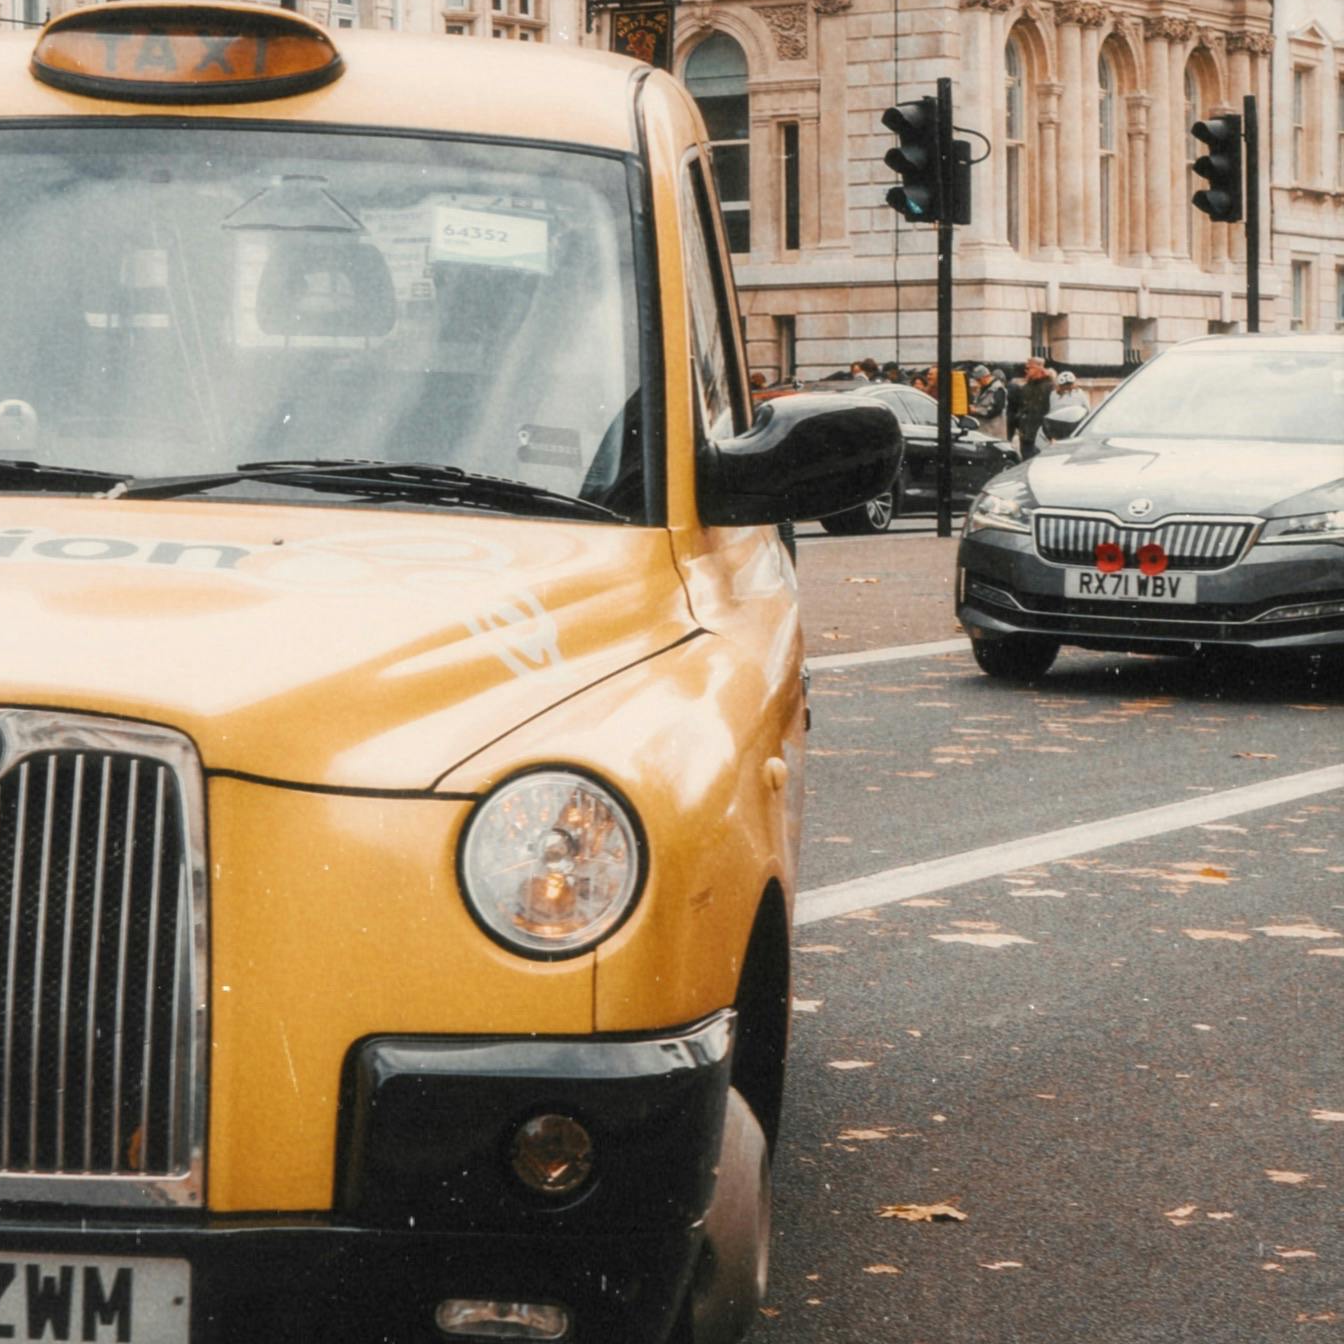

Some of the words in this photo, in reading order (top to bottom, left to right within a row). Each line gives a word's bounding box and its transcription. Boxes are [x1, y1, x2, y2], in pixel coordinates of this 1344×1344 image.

[94, 30, 270, 74] TAXI
[1079, 572, 1129, 595] RX71
[1137, 575, 1181, 598] WBV
